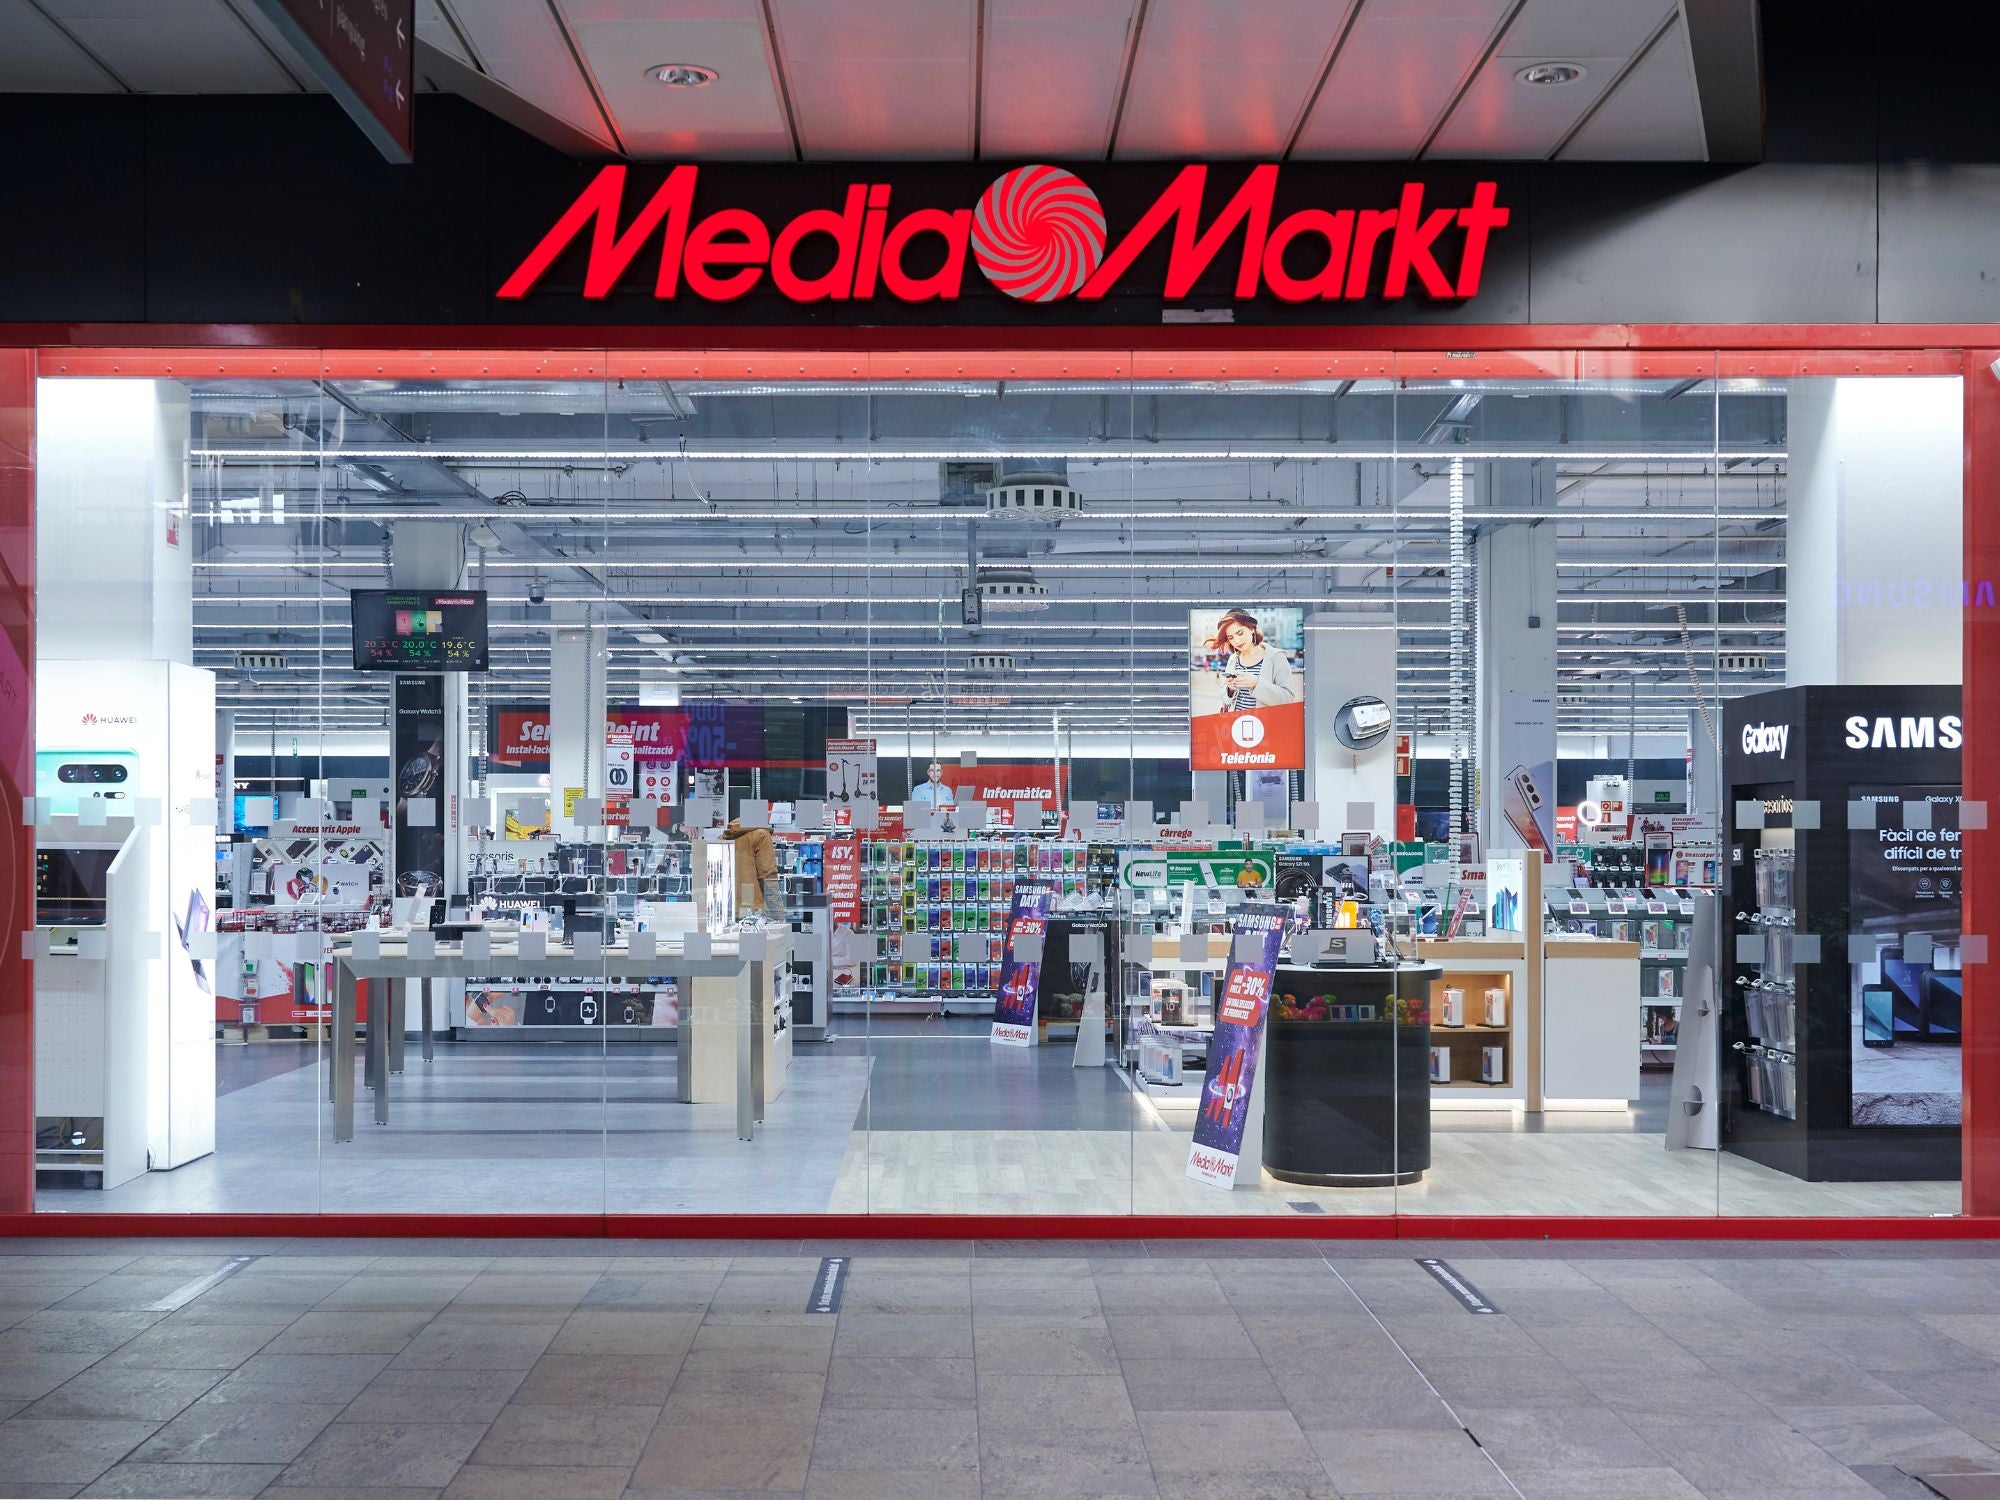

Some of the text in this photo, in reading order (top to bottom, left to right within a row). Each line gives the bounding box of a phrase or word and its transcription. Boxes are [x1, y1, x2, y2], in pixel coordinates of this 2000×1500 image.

[497, 164, 1511, 302] Media Markt
[399, 708, 420, 716] Galaxy
[100, 716, 137, 724] HUAWEI
[1742, 721, 1790, 760] Galaxy
[1221, 751, 1276, 765] Telefonia
[982, 786, 1053, 799] Informàtica
[1861, 795, 1900, 803] SAMSUNG
[1925, 795, 1953, 804] Galaxy
[292, 825, 361, 836] Accessoris Apple
[1160, 828, 1193, 839] Càrrega
[1879, 828, 1962, 842] Fàcil de fer
[1884, 846, 1923, 860] difícil
[1926, 847, 1946, 860] de
[827, 883, 858, 892] producte
[1015, 885, 1046, 895] SAMSUNG
[499, 900, 541, 909] HUAWEI
[1019, 894, 1041, 908] DAYS
[834, 911, 851, 919] preu
[1238, 913, 1276, 930] SAMSUNG
[1241, 976, 1267, 998] -30%
